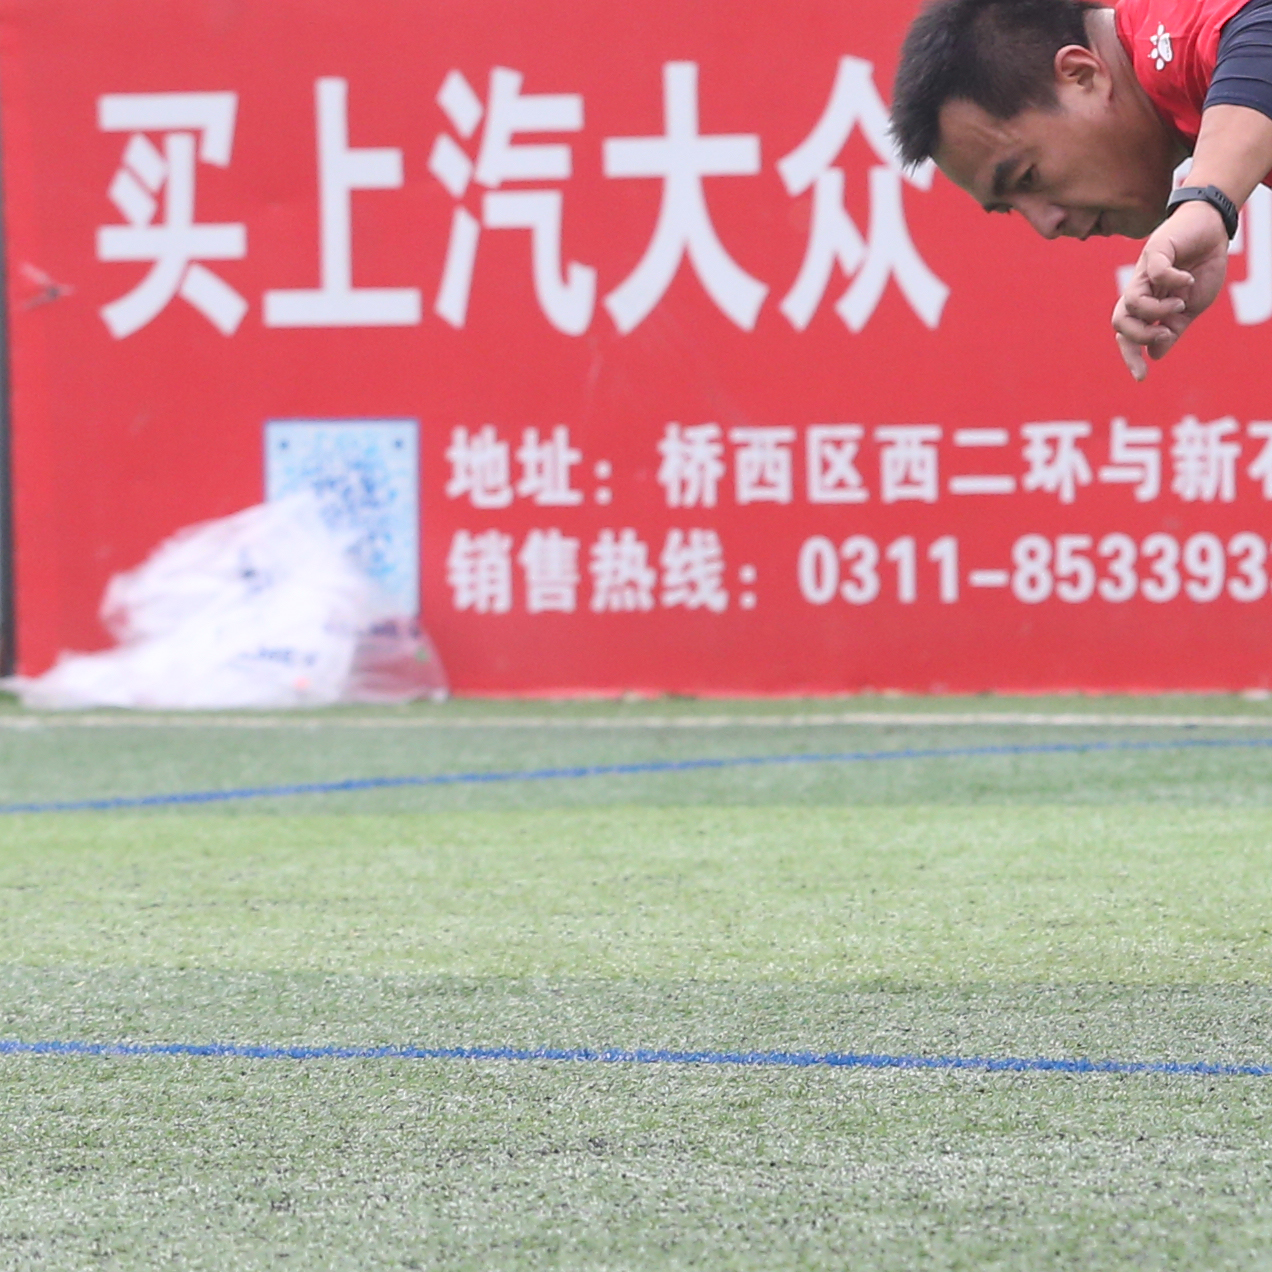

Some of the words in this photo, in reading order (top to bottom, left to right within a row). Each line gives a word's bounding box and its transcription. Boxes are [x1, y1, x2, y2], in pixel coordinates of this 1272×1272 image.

[97, 55, 952, 340] 买上汽大众
